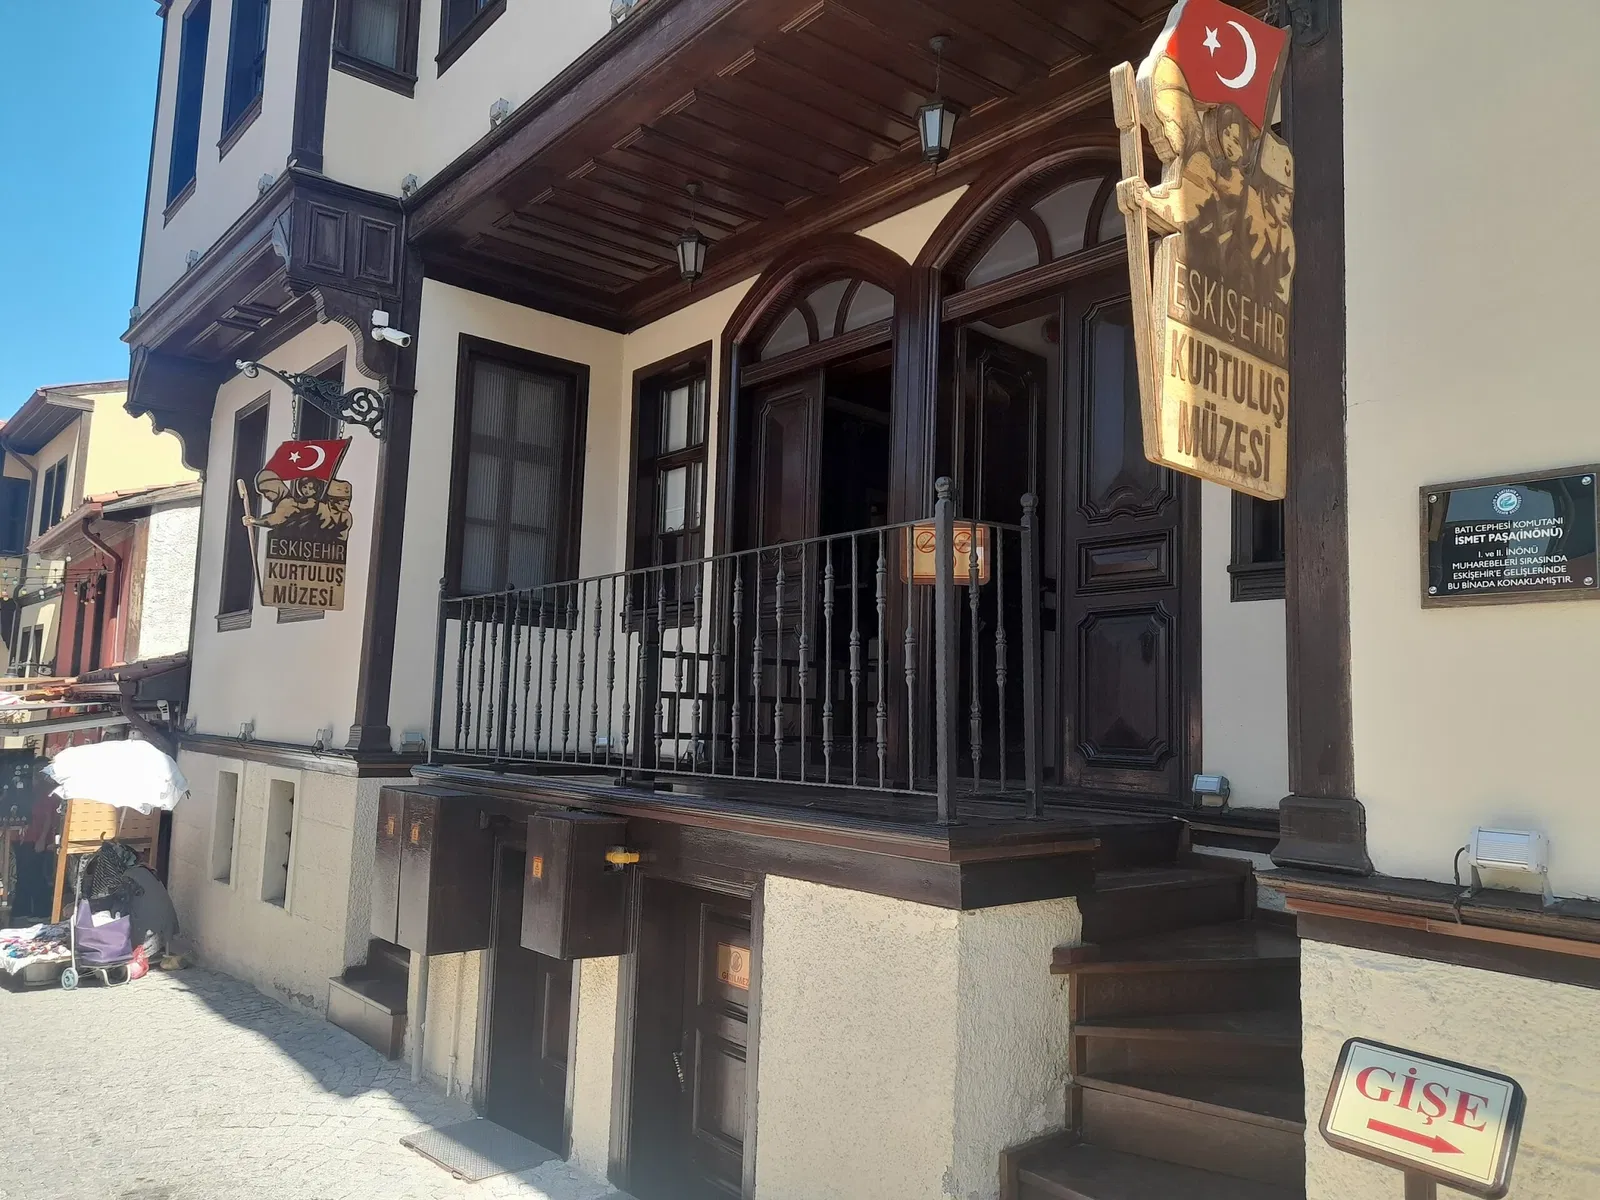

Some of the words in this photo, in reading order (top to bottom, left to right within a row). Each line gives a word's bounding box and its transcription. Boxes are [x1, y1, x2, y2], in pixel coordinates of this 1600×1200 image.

[1173, 260, 1286, 358] ESKİŞEHİR
[1170, 329, 1285, 429] KURTULUŞ
[1177, 400, 1271, 482] MÜZESİ
[1454, 526, 1473, 534] BATI
[1475, 521, 1510, 532] CEPHESİ
[1513, 517, 1564, 529] KOMUTANI
[269, 538, 345, 561] ESKİŞEHİR
[1455, 534, 1486, 545] İSMET
[1496, 549, 1504, 557] II.
[1505, 545, 1539, 556] İNÖNÜ
[268, 562, 344, 586] KURTULUŞ
[1452, 557, 1518, 570] MUHAREBELERİ
[1520, 555, 1568, 565] SIRASINDA
[1453, 569, 1501, 580] ESKİŞEHİR'E
[1503, 565, 1567, 577] GELİŞLERİNDE
[273, 583, 335, 607] MÜZESİ
[1448, 582, 1460, 590] BU
[1461, 579, 1496, 589] BİNADA
[1355, 1066, 1490, 1133] GİŞE
